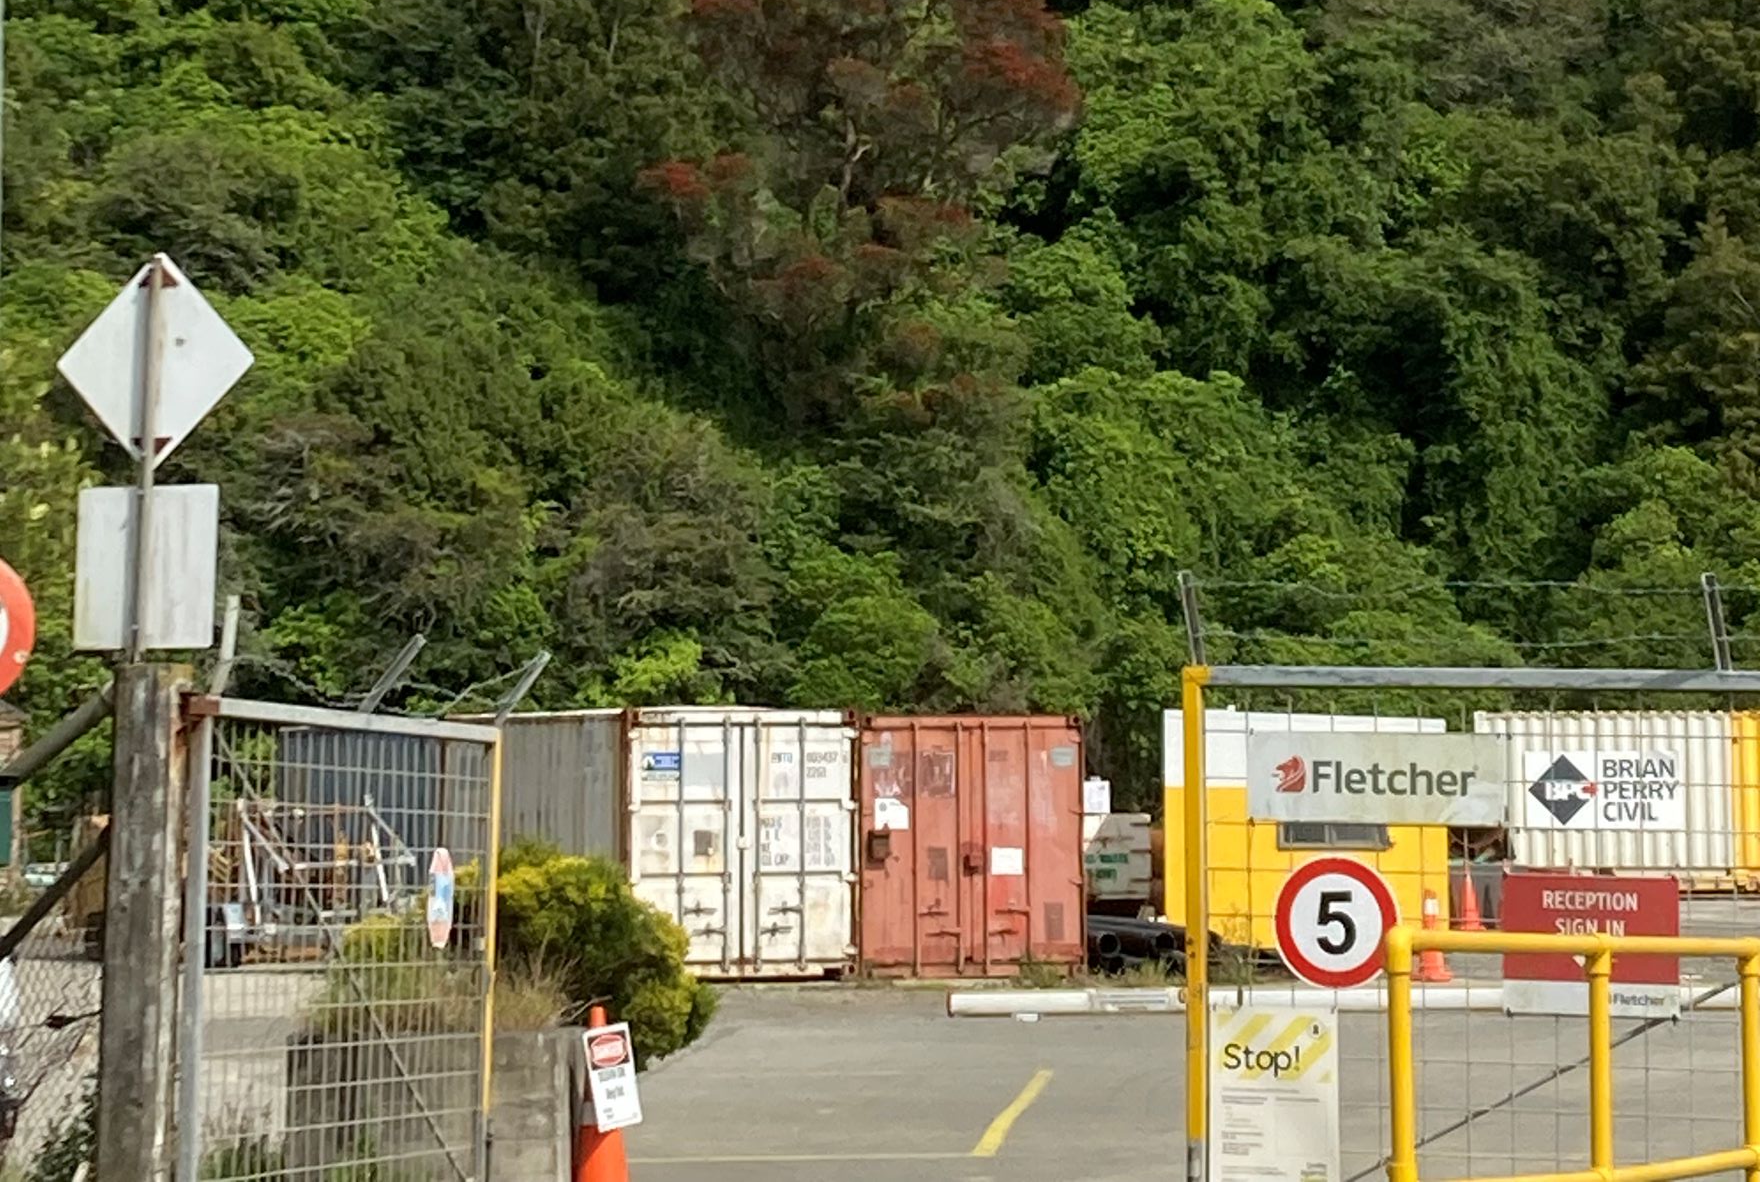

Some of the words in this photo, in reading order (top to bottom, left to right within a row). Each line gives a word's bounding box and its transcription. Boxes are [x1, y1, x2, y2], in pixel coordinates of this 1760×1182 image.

[1312, 760, 1476, 797] Fletcher
[1602, 758, 1676, 778] BRIAN
[1603, 780, 1680, 800] PERRY
[1603, 801, 1659, 822] CIVIL
[1541, 889, 1639, 912] RECEPTION
[1316, 890, 1357, 956] 5
[1554, 917, 1599, 936] SIGN
[1605, 919, 1626, 937] IN
[1612, 992, 1665, 1007] Fletcher
[1223, 1043, 1301, 1079] Stop!
